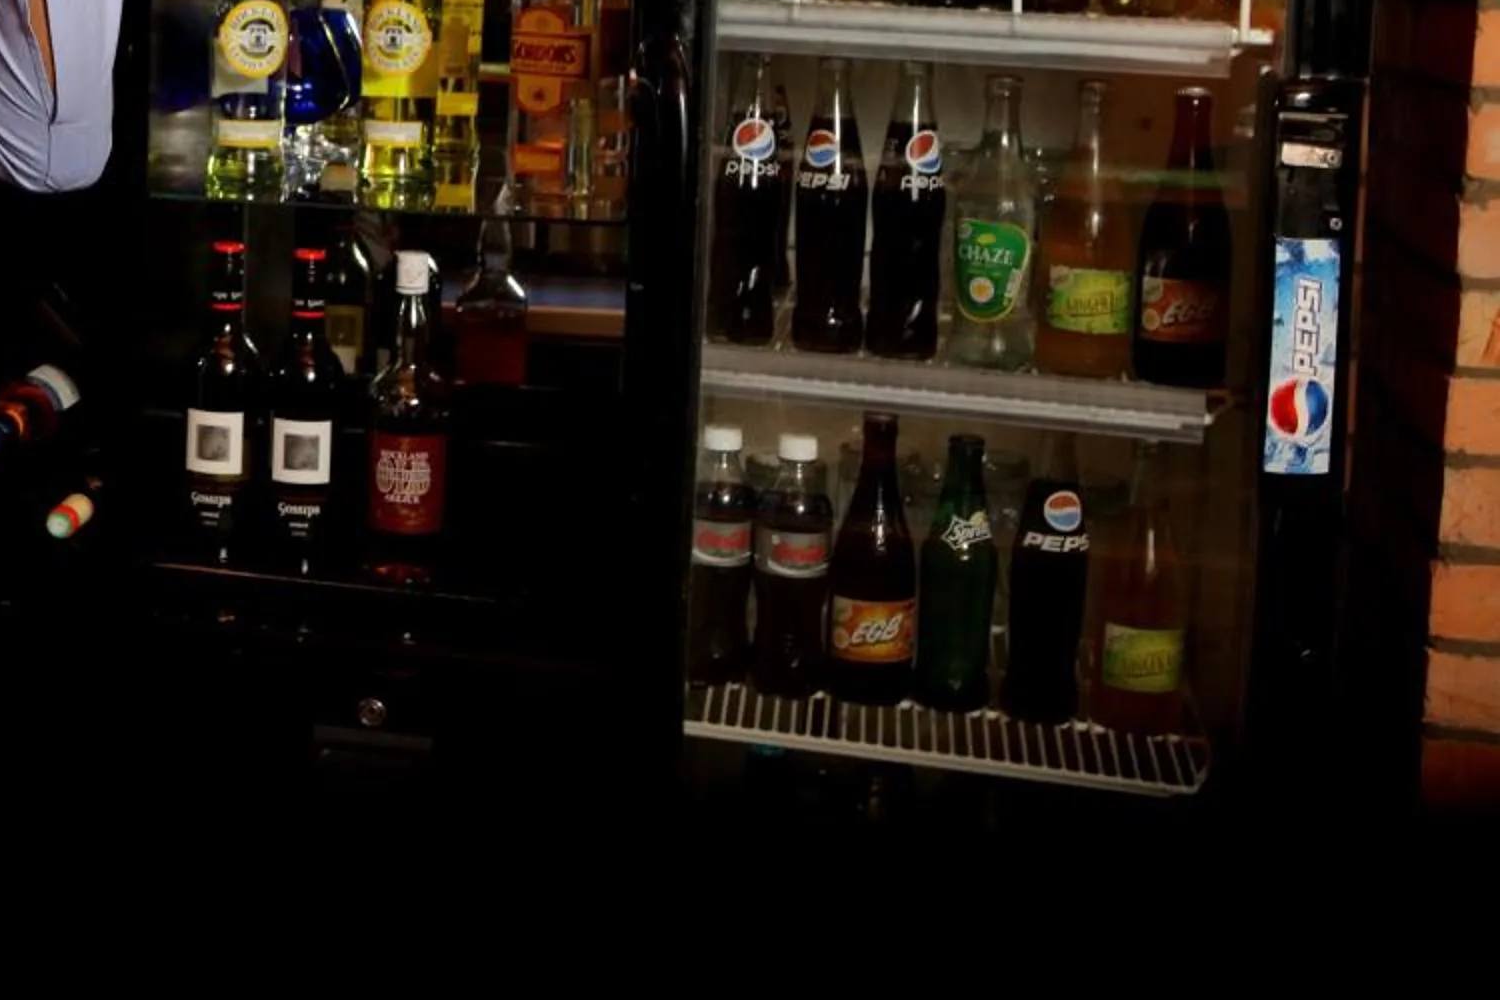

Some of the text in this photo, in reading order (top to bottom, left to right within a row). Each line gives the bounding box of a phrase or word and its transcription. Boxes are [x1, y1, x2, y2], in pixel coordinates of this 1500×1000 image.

[725, 159, 781, 179] pepsi
[798, 171, 851, 191] EPSI
[1291, 278, 1323, 377] PEPSI
[1023, 531, 1091, 553] PEPS
[851, 613, 904, 645] EGB
